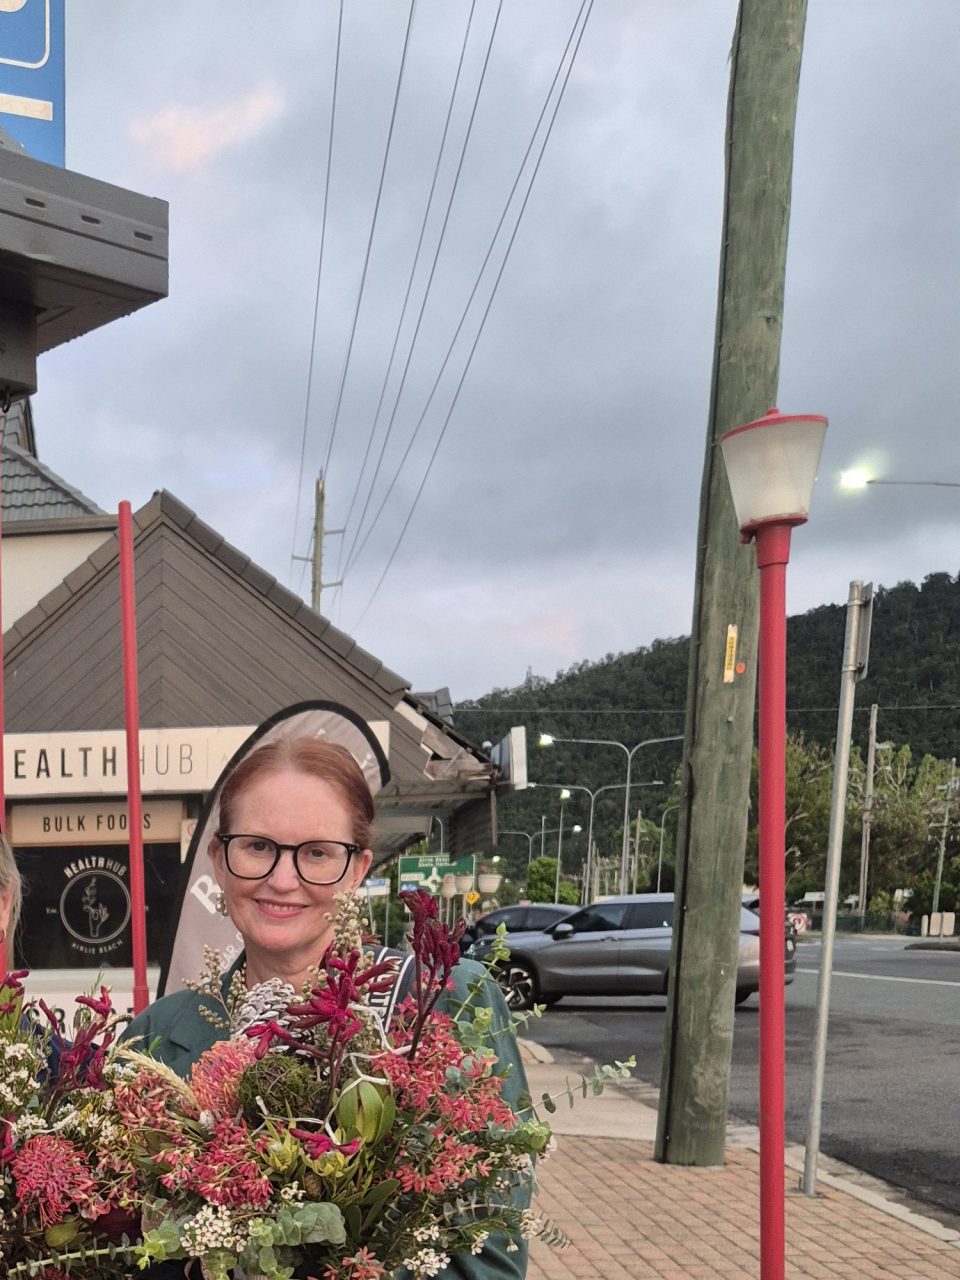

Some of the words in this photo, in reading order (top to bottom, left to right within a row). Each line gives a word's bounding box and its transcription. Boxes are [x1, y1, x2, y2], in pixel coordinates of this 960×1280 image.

[14, 745, 117, 779] EALTH
[43, 814, 86, 833] BULK
[96, 812, 152, 831] FOOS
